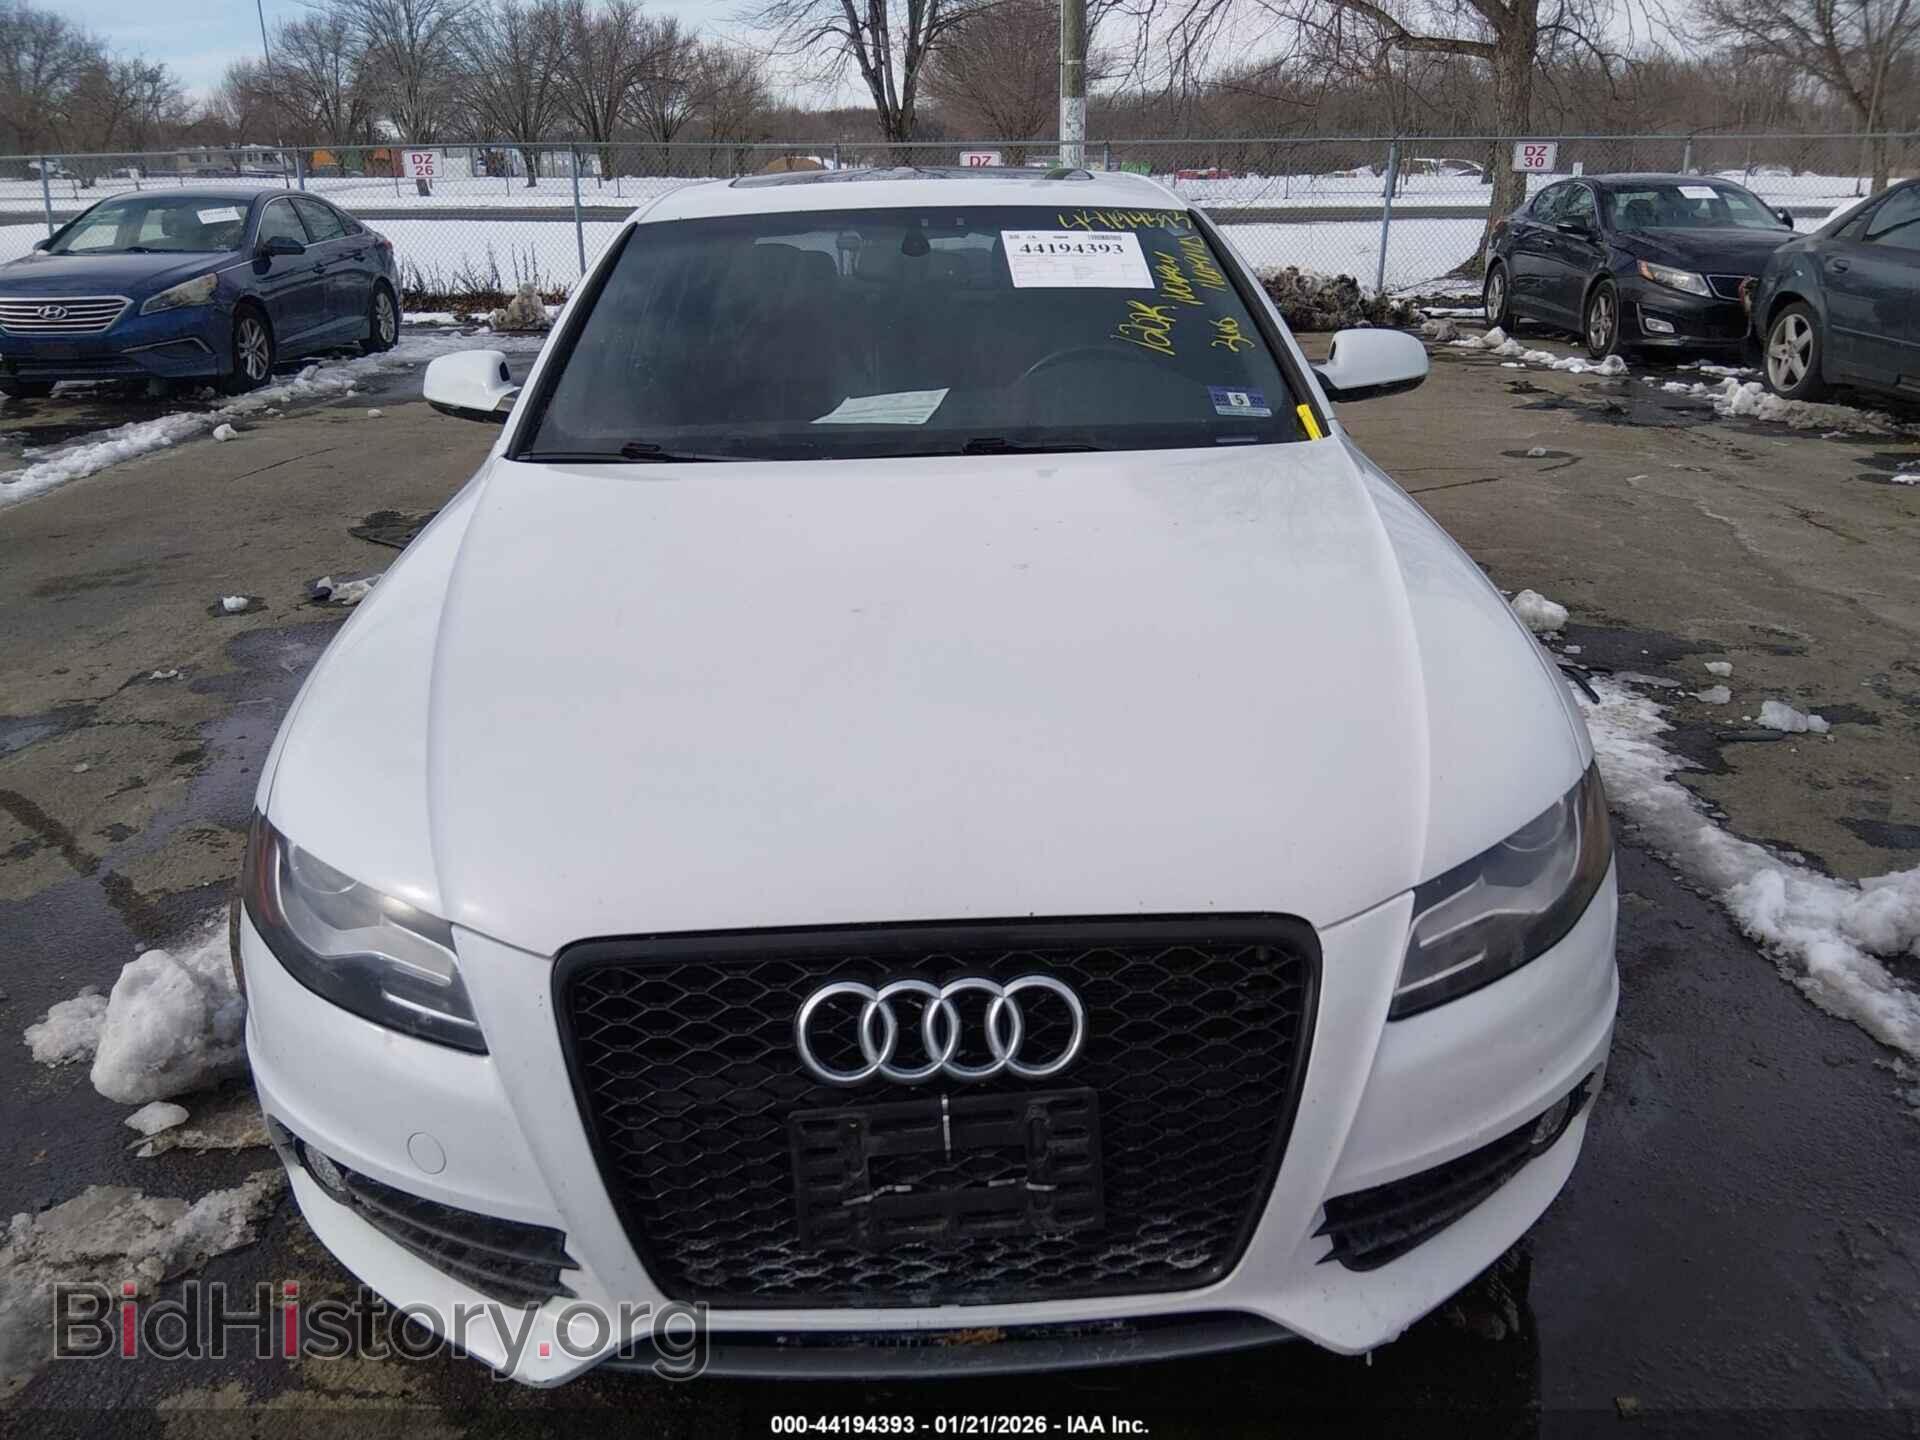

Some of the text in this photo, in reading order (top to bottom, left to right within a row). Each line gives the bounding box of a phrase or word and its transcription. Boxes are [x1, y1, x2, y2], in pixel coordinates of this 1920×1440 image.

[1524, 145, 1548, 156] DZ
[411, 153, 433, 164] DZ
[970, 155, 992, 168] DZ
[1524, 157, 1545, 168] 30
[415, 165, 434, 176] 26
[1019, 243, 1124, 255] 44194393
[1234, 394, 1245, 406] 5
